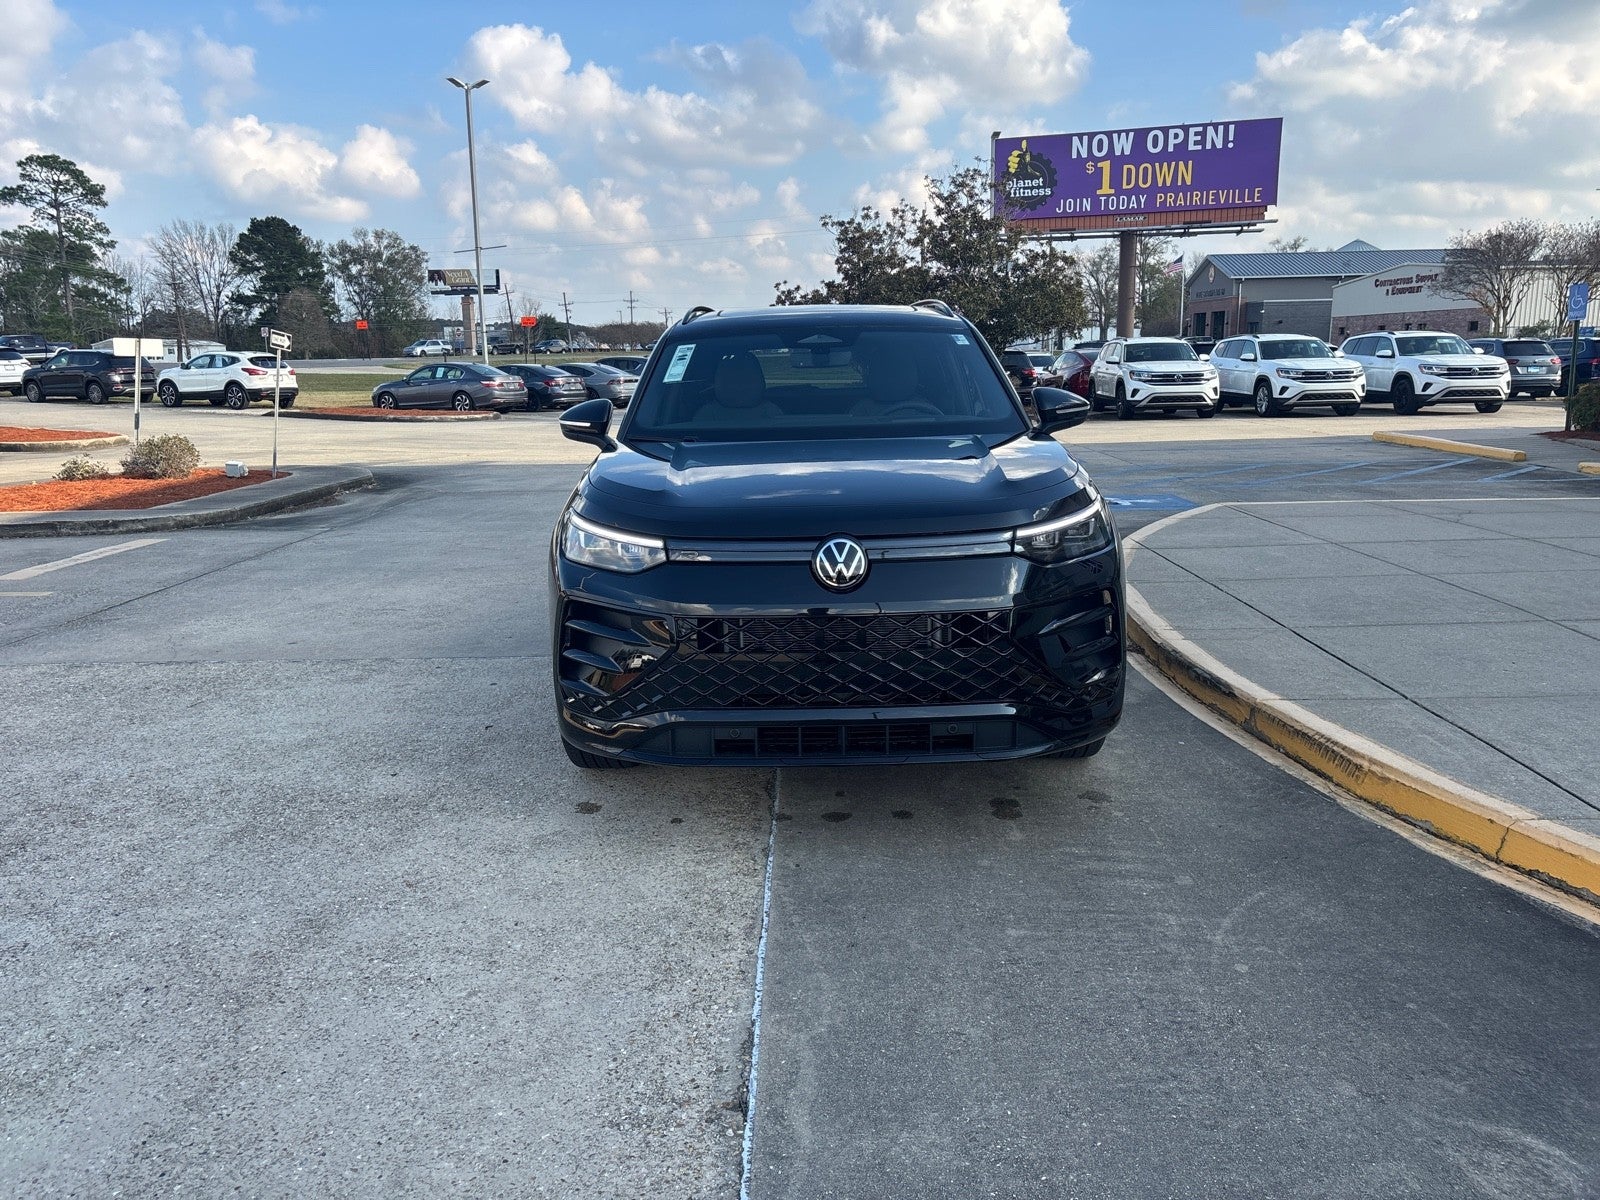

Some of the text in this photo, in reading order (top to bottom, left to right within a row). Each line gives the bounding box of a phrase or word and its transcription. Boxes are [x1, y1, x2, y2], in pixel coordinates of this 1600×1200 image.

[1071, 124, 1235, 159] NOW OPEN!
[1006, 176, 1044, 191] planet
[1122, 160, 1193, 190] DOWN
[1009, 187, 1052, 197] fitness
[1056, 187, 1263, 213] JOIN TODAY PRAIRIEVILLE
